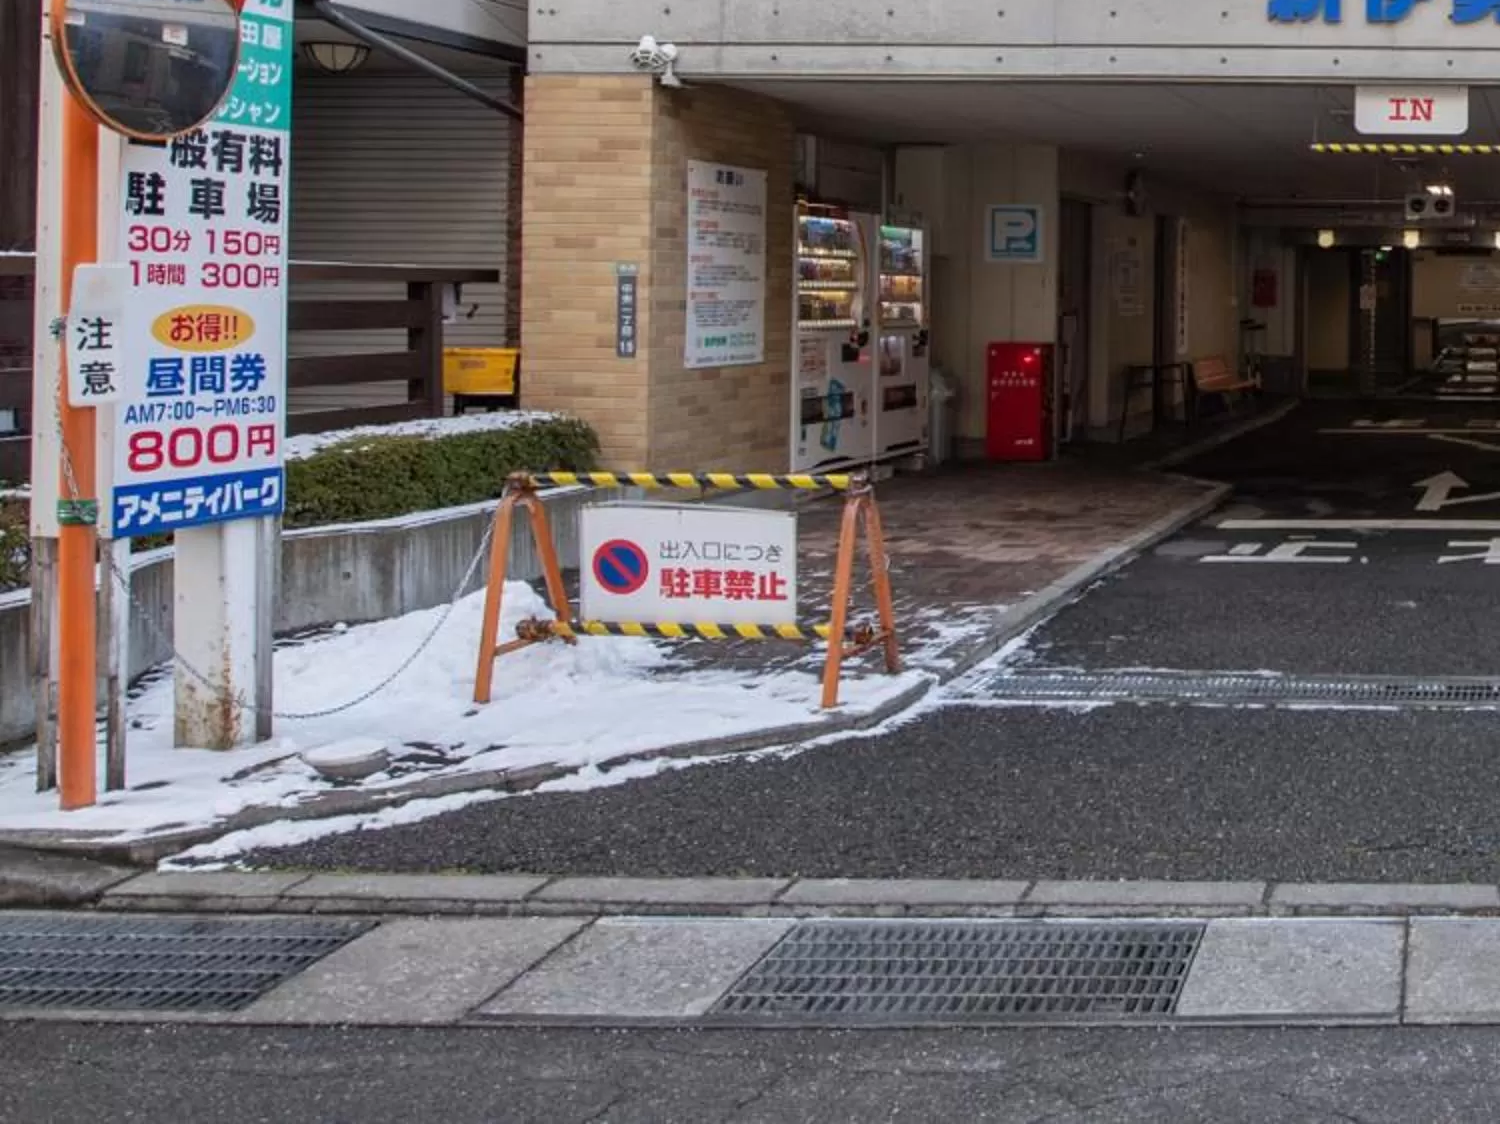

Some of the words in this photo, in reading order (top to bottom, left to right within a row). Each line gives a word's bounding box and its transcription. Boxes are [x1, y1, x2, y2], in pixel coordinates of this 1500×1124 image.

[1389, 98, 1434, 121] IN
[128, 128, 283, 177] 一般有料
[128, 225, 192, 253] 30分
[205, 229, 280, 256] 150円
[129, 260, 185, 287] 1時間
[201, 263, 279, 288] 300円
[77, 317, 116, 396] 注意
[146, 353, 266, 397] 昼間券
[128, 424, 276, 473] 800円
[116, 476, 280, 529] アメニティパーク
[660, 540, 784, 563] 出入口につき
[659, 568, 788, 601] 駐車禁止
